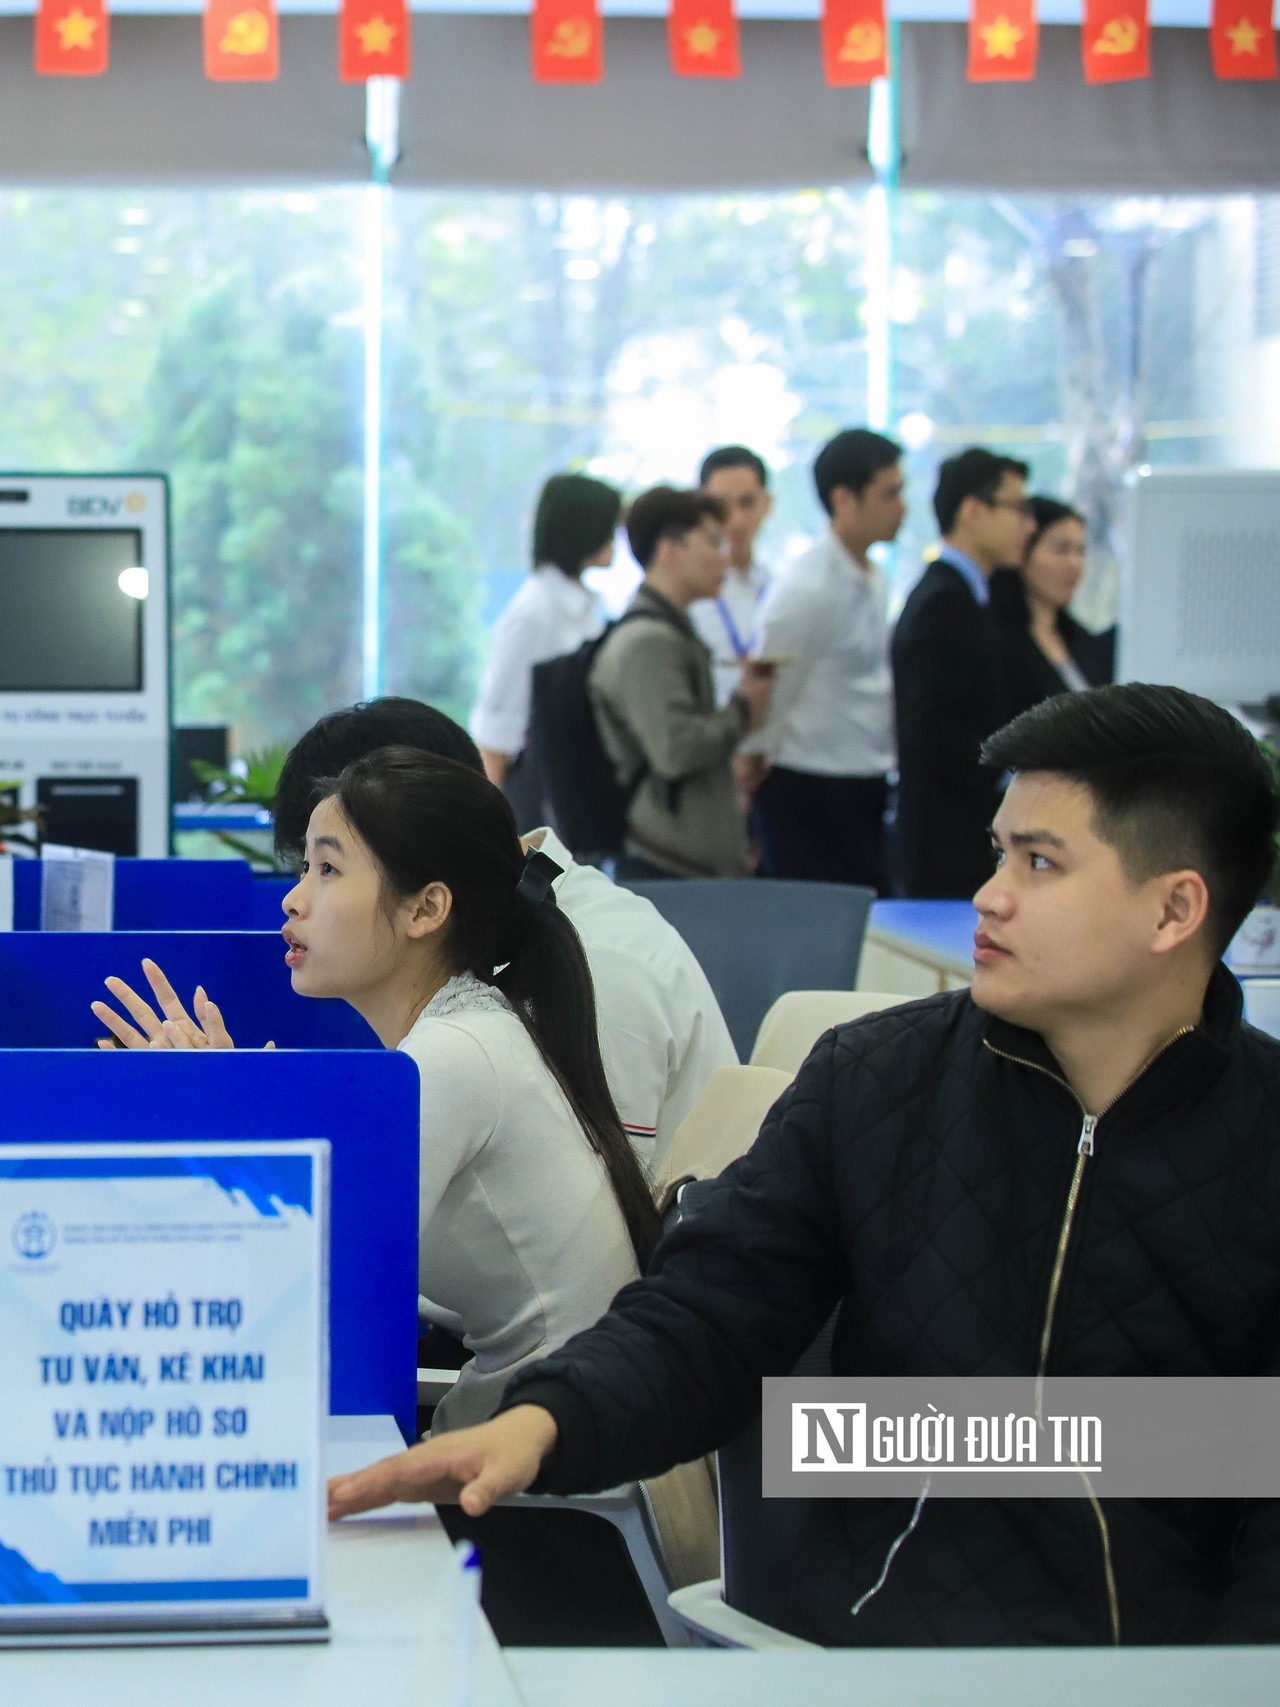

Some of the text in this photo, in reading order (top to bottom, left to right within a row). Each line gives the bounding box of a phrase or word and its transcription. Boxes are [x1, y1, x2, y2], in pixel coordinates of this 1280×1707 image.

[202, 1354, 265, 1382] KHAI
[99, 1407, 155, 1446] NỘP
[69, 1464, 120, 1500] TỤC
